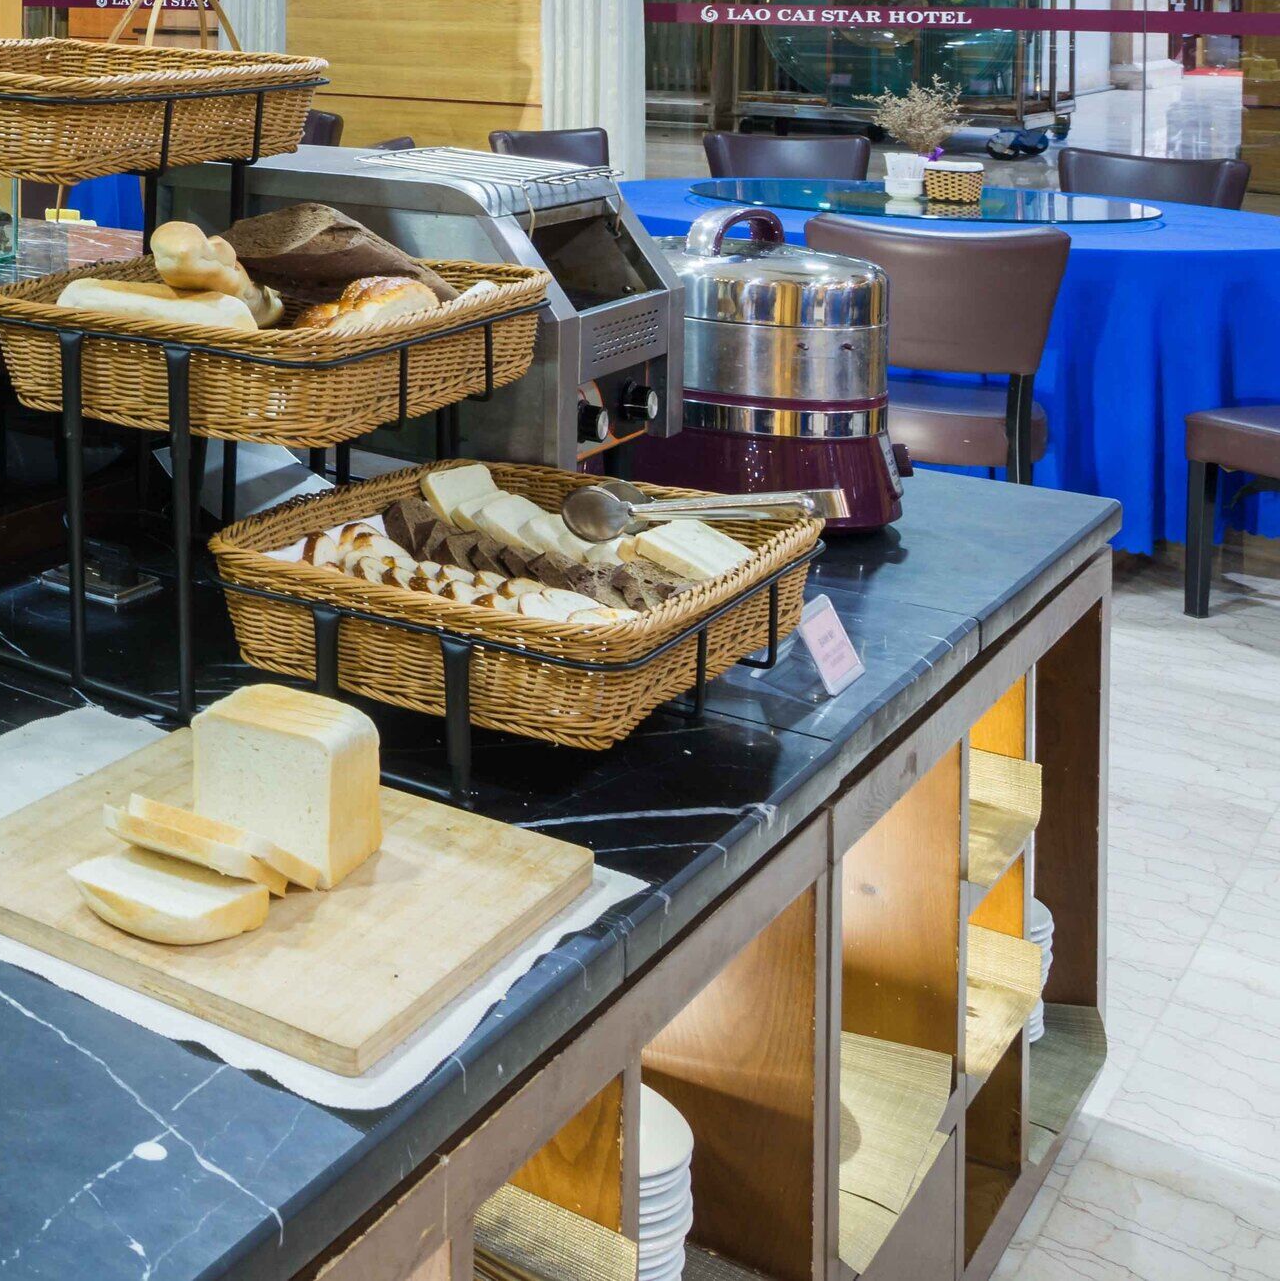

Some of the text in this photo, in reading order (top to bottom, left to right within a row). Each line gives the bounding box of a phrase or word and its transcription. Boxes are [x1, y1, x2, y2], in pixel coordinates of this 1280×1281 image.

[727, 7, 972, 25] LAO CAI STAR HOTEL
